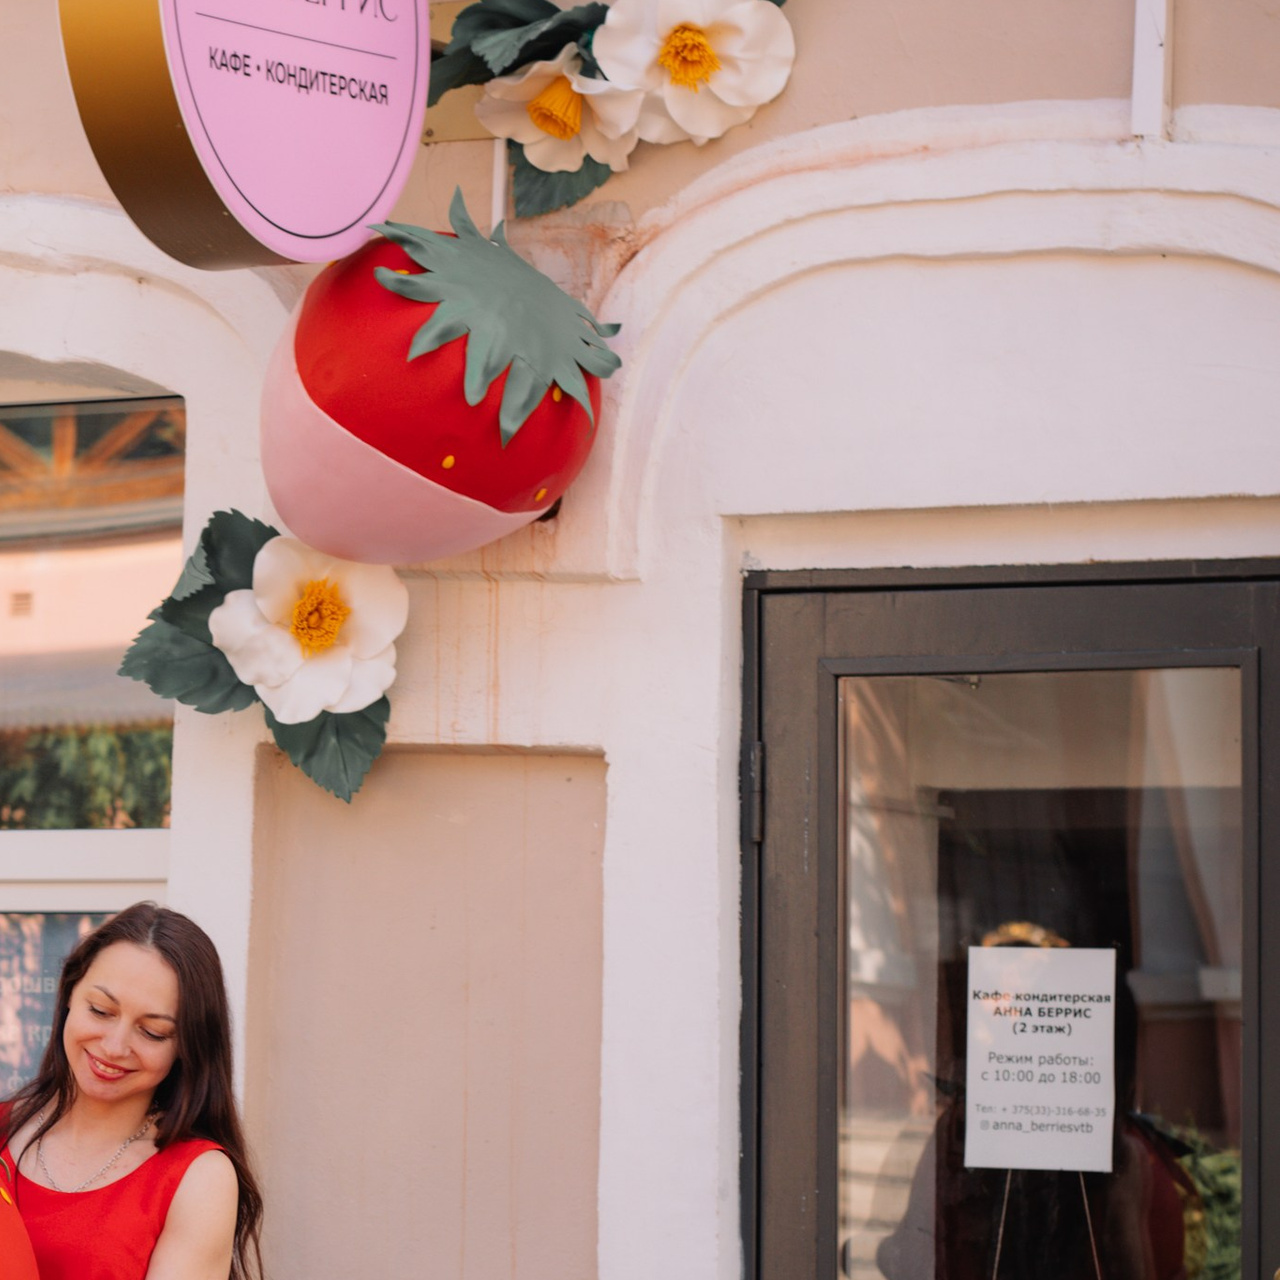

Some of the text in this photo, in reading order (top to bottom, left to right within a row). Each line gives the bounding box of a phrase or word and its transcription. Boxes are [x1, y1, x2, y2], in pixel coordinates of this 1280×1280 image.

[209, 47, 389, 105] КАФЕ КОНДИТЕРСКАЯ
[993, 1006, 1092, 1019] АННА БЕРРИС
[1012, 1022, 1073, 1036] (2 этаж)
[988, 1052, 1095, 1067] Режим работы:
[981, 1070, 1101, 1084] с 10:00 до 18:00
